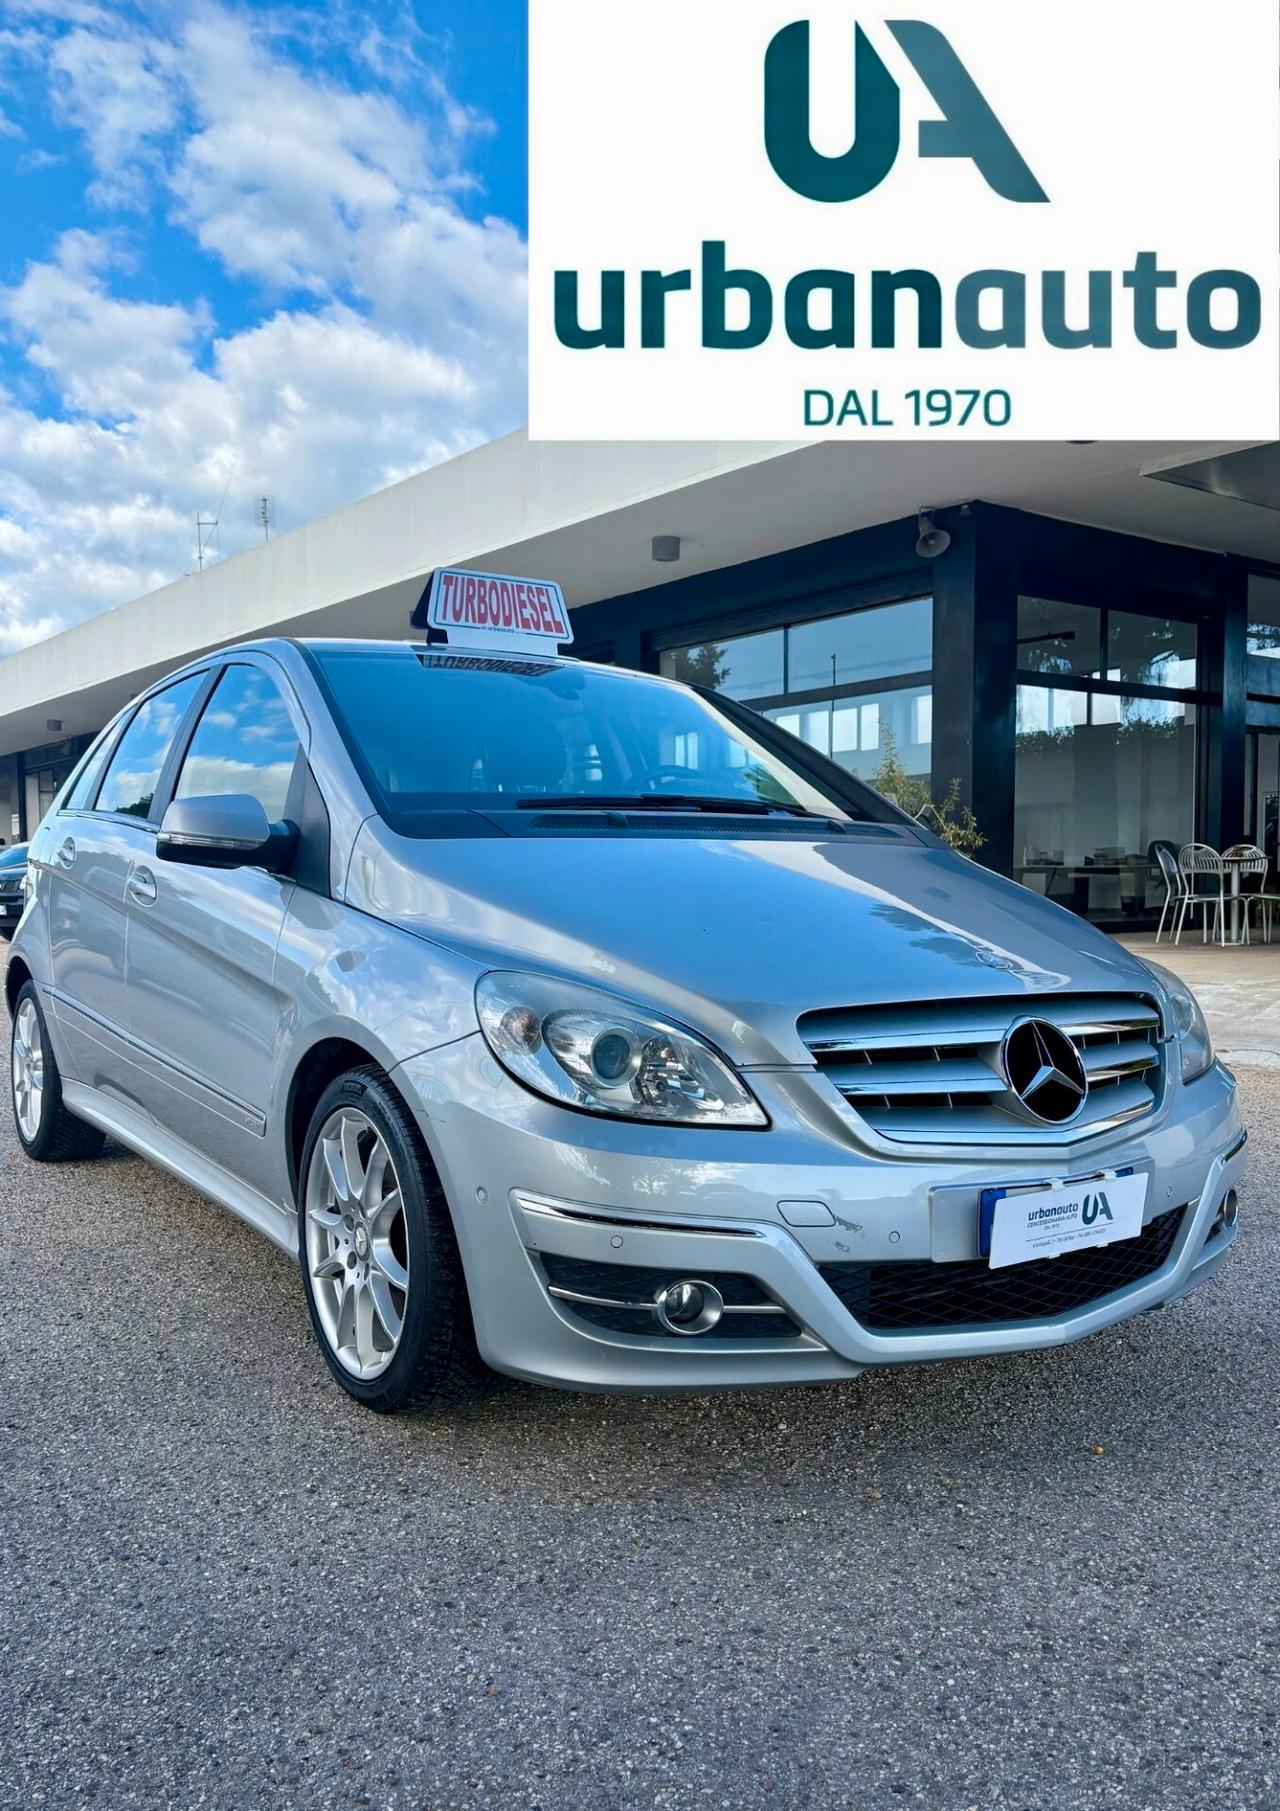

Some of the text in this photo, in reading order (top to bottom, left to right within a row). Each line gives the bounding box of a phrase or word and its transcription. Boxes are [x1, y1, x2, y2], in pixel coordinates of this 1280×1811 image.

[441, 574, 565, 635] TURBODIESEL
[1028, 1202, 1079, 1221] urbanauto
[1082, 1191, 1114, 1225] UA
